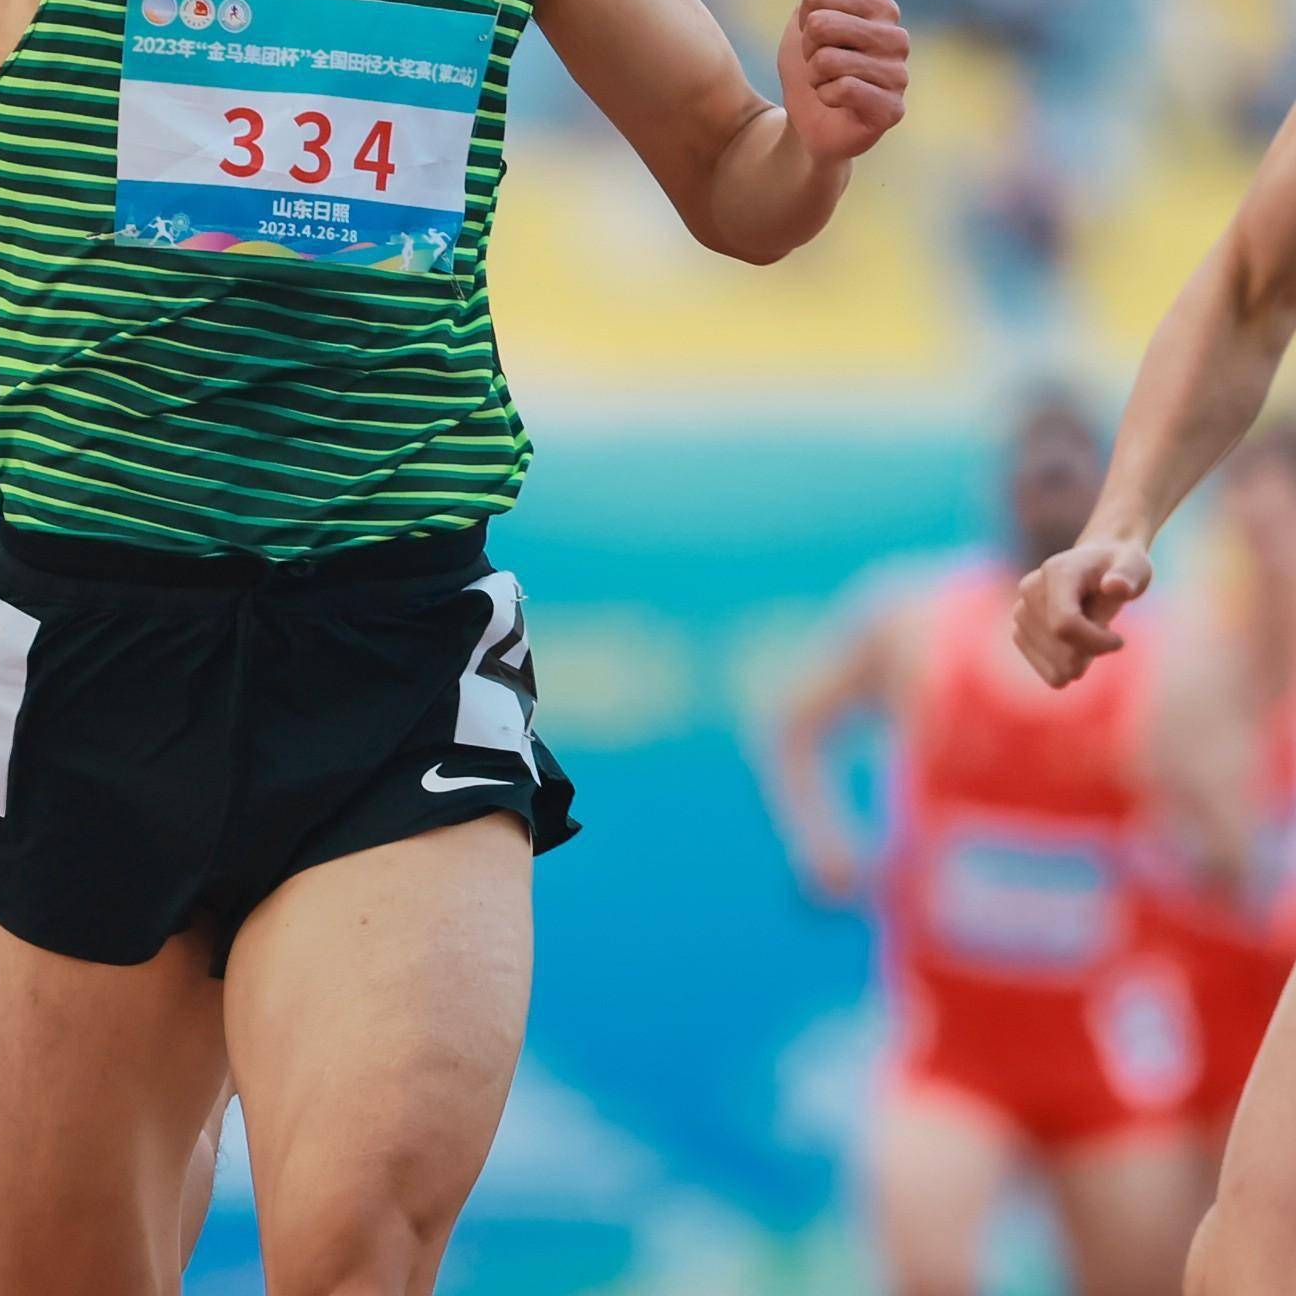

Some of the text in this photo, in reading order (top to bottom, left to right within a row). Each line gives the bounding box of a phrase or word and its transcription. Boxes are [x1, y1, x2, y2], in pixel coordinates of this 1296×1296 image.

[219, 107, 396, 192] 334
[272, 197, 351, 224] 山东日照
[257, 220, 358, 243] 2023.4.26-28
